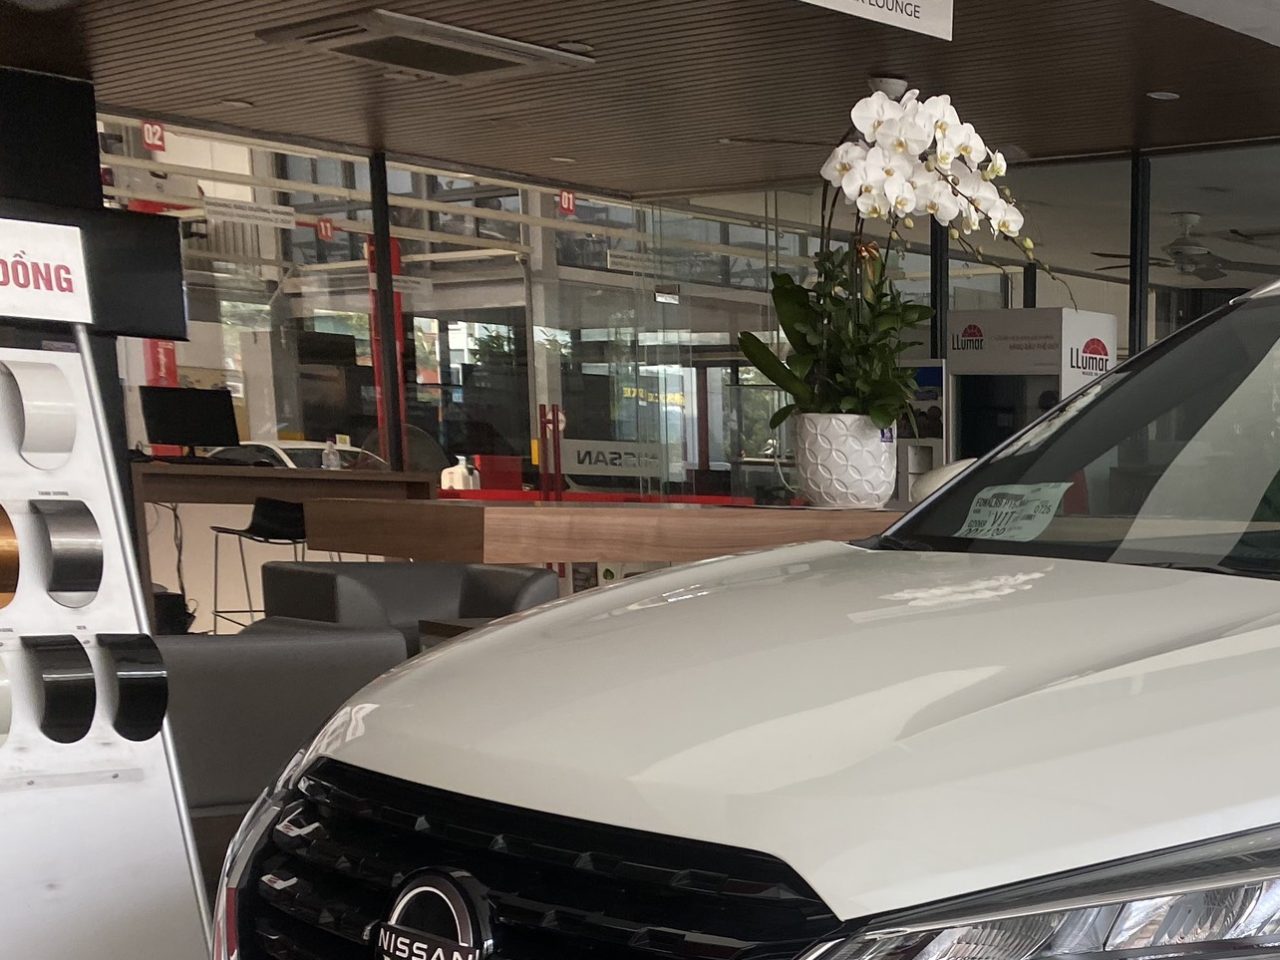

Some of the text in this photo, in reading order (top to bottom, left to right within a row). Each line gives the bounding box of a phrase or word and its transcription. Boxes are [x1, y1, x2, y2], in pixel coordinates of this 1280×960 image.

[143, 123, 163, 146] 02
[561, 191, 574, 211] 01
[1070, 347, 1110, 372] LLumar
